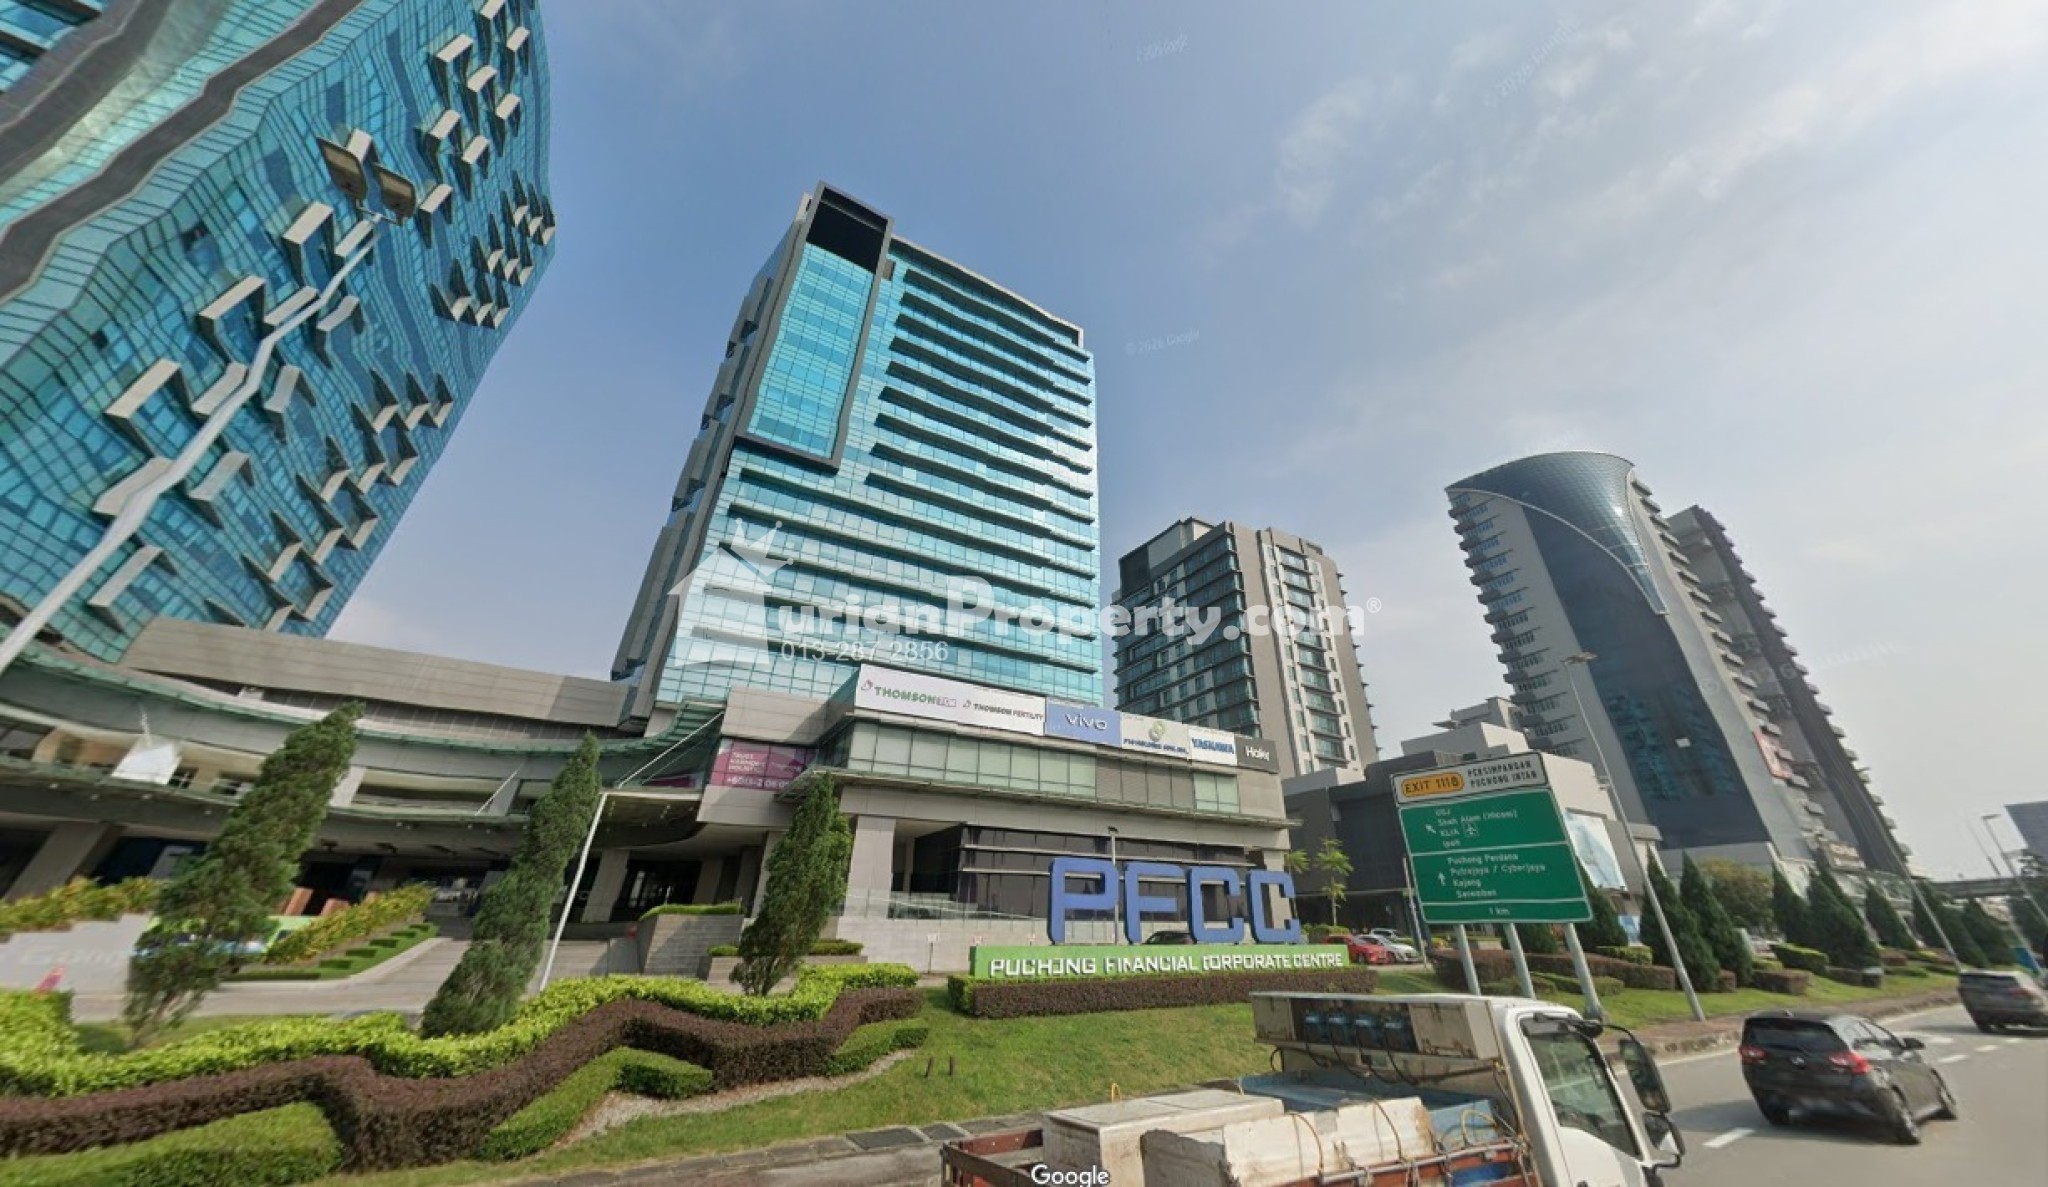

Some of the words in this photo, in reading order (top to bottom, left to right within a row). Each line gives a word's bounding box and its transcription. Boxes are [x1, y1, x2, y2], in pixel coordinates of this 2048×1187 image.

[875, 686, 936, 706] THOMSON
[1064, 713, 1108, 731] vivo
[1467, 760, 1532, 777] PERSIMPANGAN
[1405, 780, 1430, 793] EXIT
[1470, 774, 1509, 788] PUCHONG
[1512, 770, 1538, 782] INTAN
[1447, 856, 1483, 866] Puchong
[1453, 878, 1482, 889] Kajang
[1048, 857, 1300, 945] PFCC
[1103, 955, 1200, 974] FINANCIAL
[1203, 954, 1292, 971] CORPORATE
[1293, 952, 1344, 968] CENTRE
